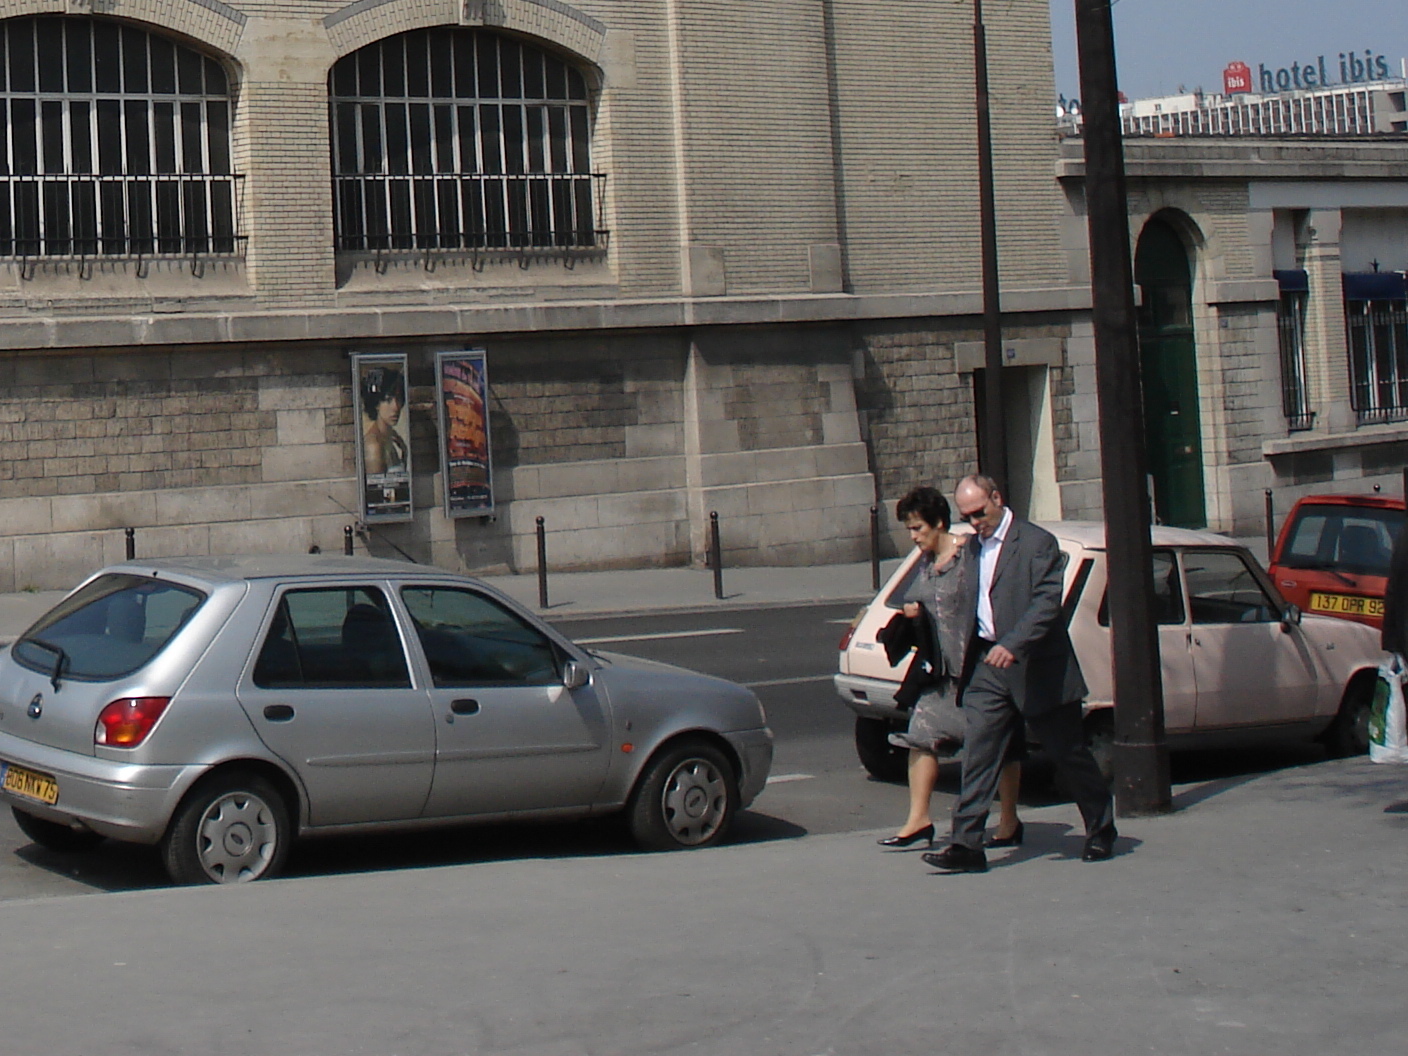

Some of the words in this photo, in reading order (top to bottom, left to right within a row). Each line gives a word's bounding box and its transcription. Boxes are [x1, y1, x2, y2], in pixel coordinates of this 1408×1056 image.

[1259, 55, 1327, 93] hotel
[1338, 49, 1388, 84] ibis
[1228, 76, 1245, 88] ibis
[1317, 595, 1338, 610] 137
[43, 781, 57, 801] 75
